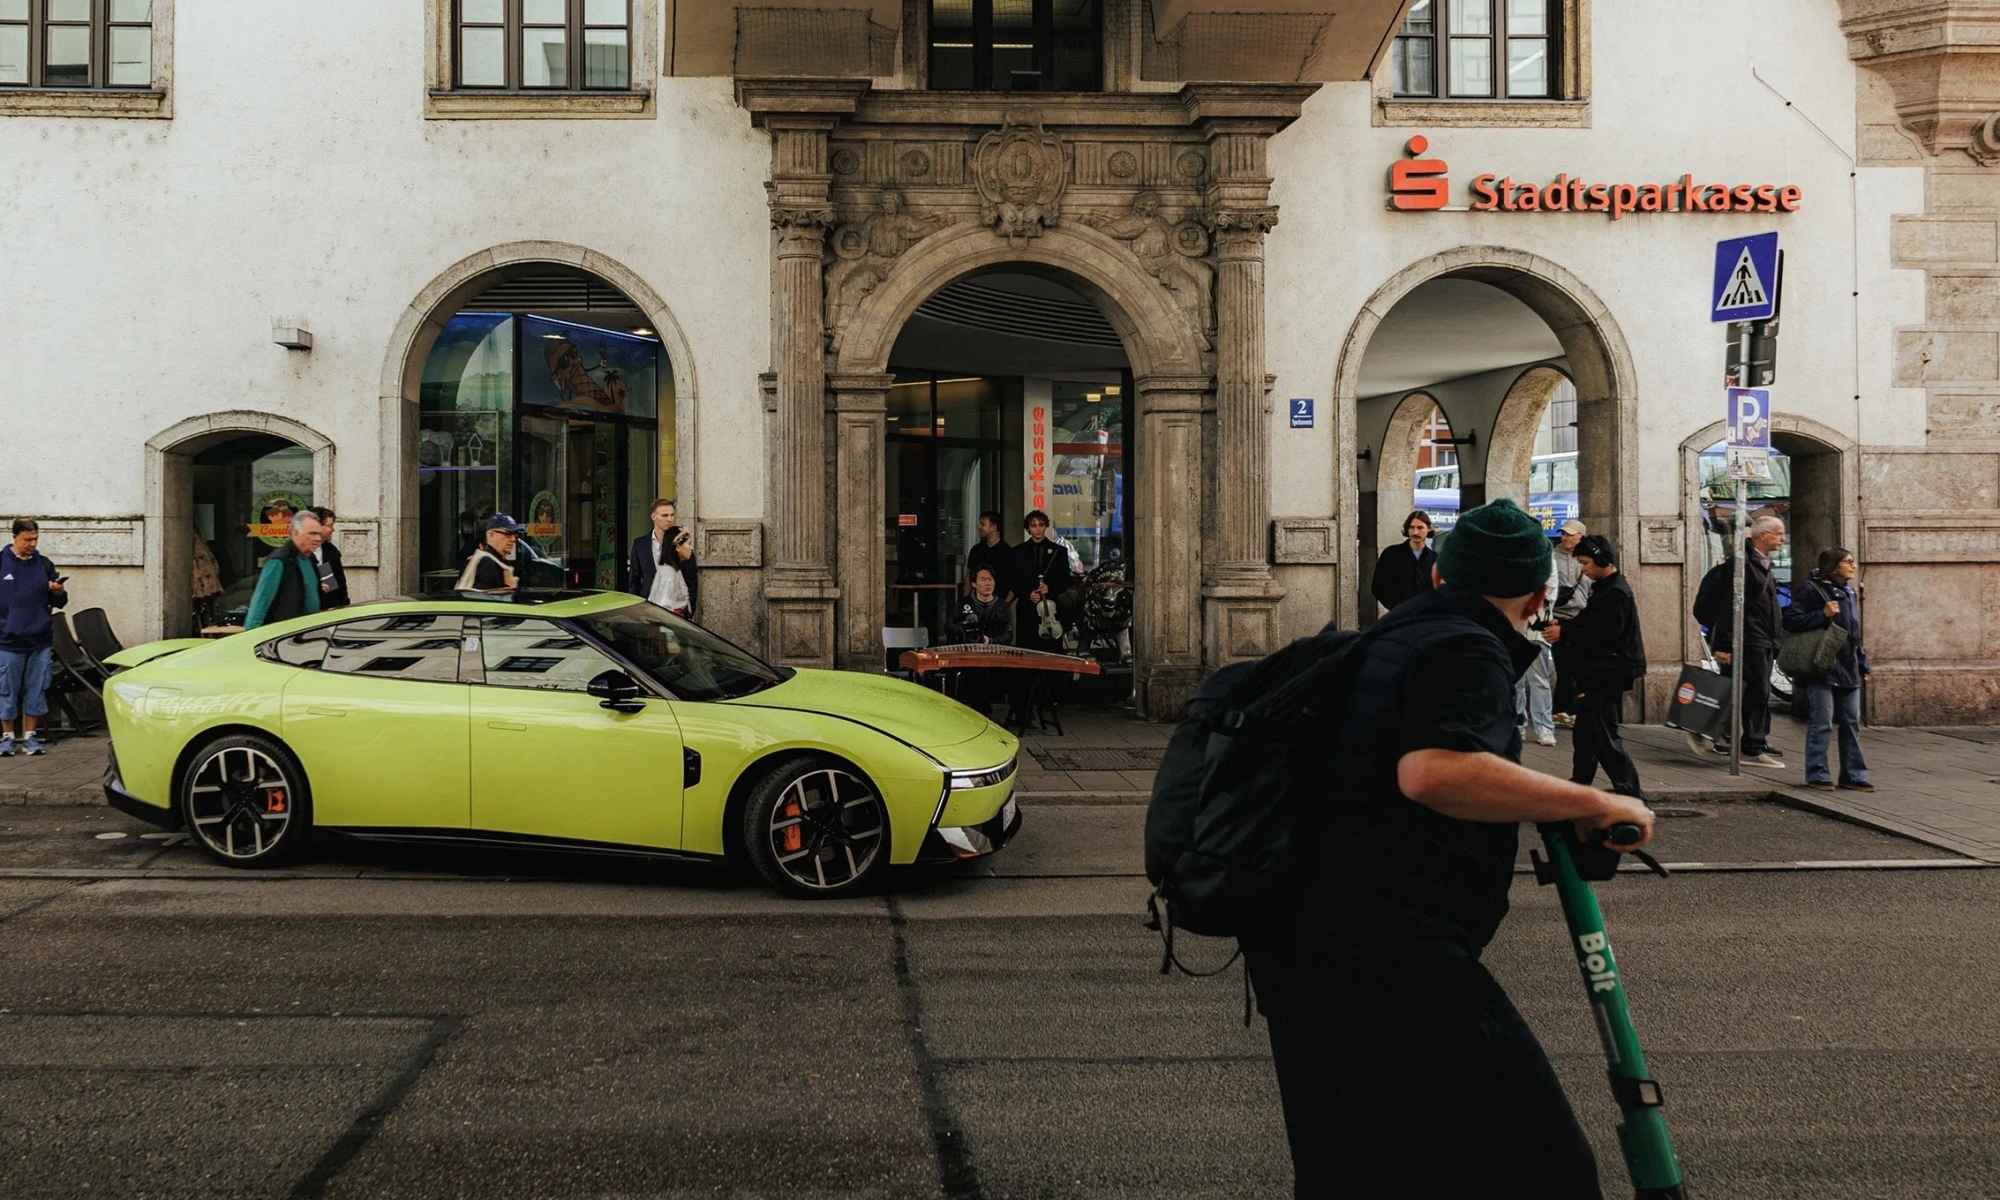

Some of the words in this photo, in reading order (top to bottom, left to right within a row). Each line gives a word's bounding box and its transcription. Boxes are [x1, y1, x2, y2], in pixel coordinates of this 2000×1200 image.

[1471, 172, 1803, 220] Stadtsparkasse
[1297, 400, 1307, 414] 2
[1736, 395, 1761, 440] P
[1578, 930, 1616, 993] Bolt
